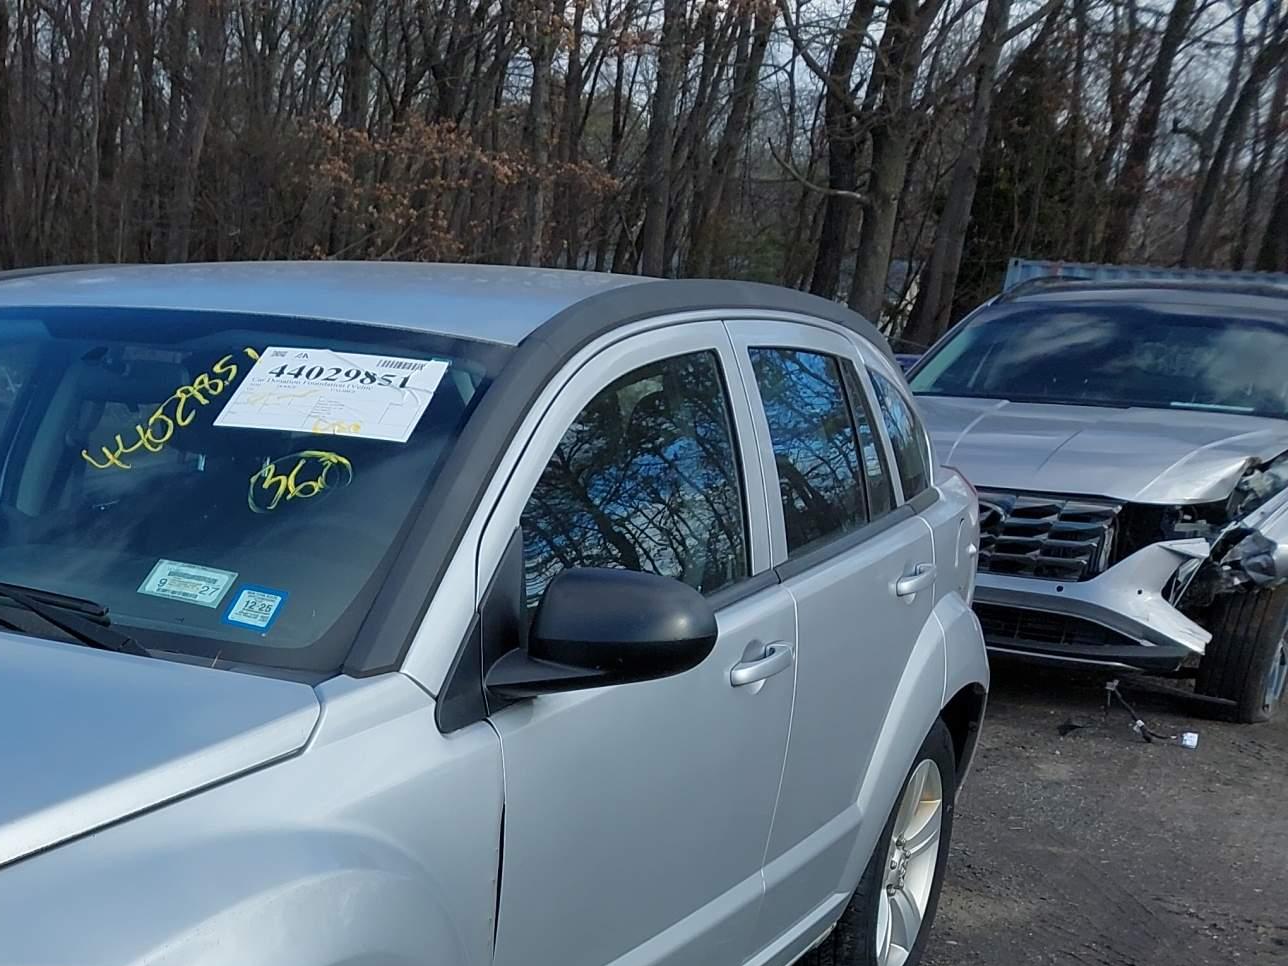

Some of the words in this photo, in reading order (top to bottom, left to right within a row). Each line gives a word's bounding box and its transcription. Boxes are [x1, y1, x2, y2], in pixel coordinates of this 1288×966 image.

[268, 363, 414, 389] 44029851
[157, 578, 168, 588] 9
[199, 585, 220, 597] 27
